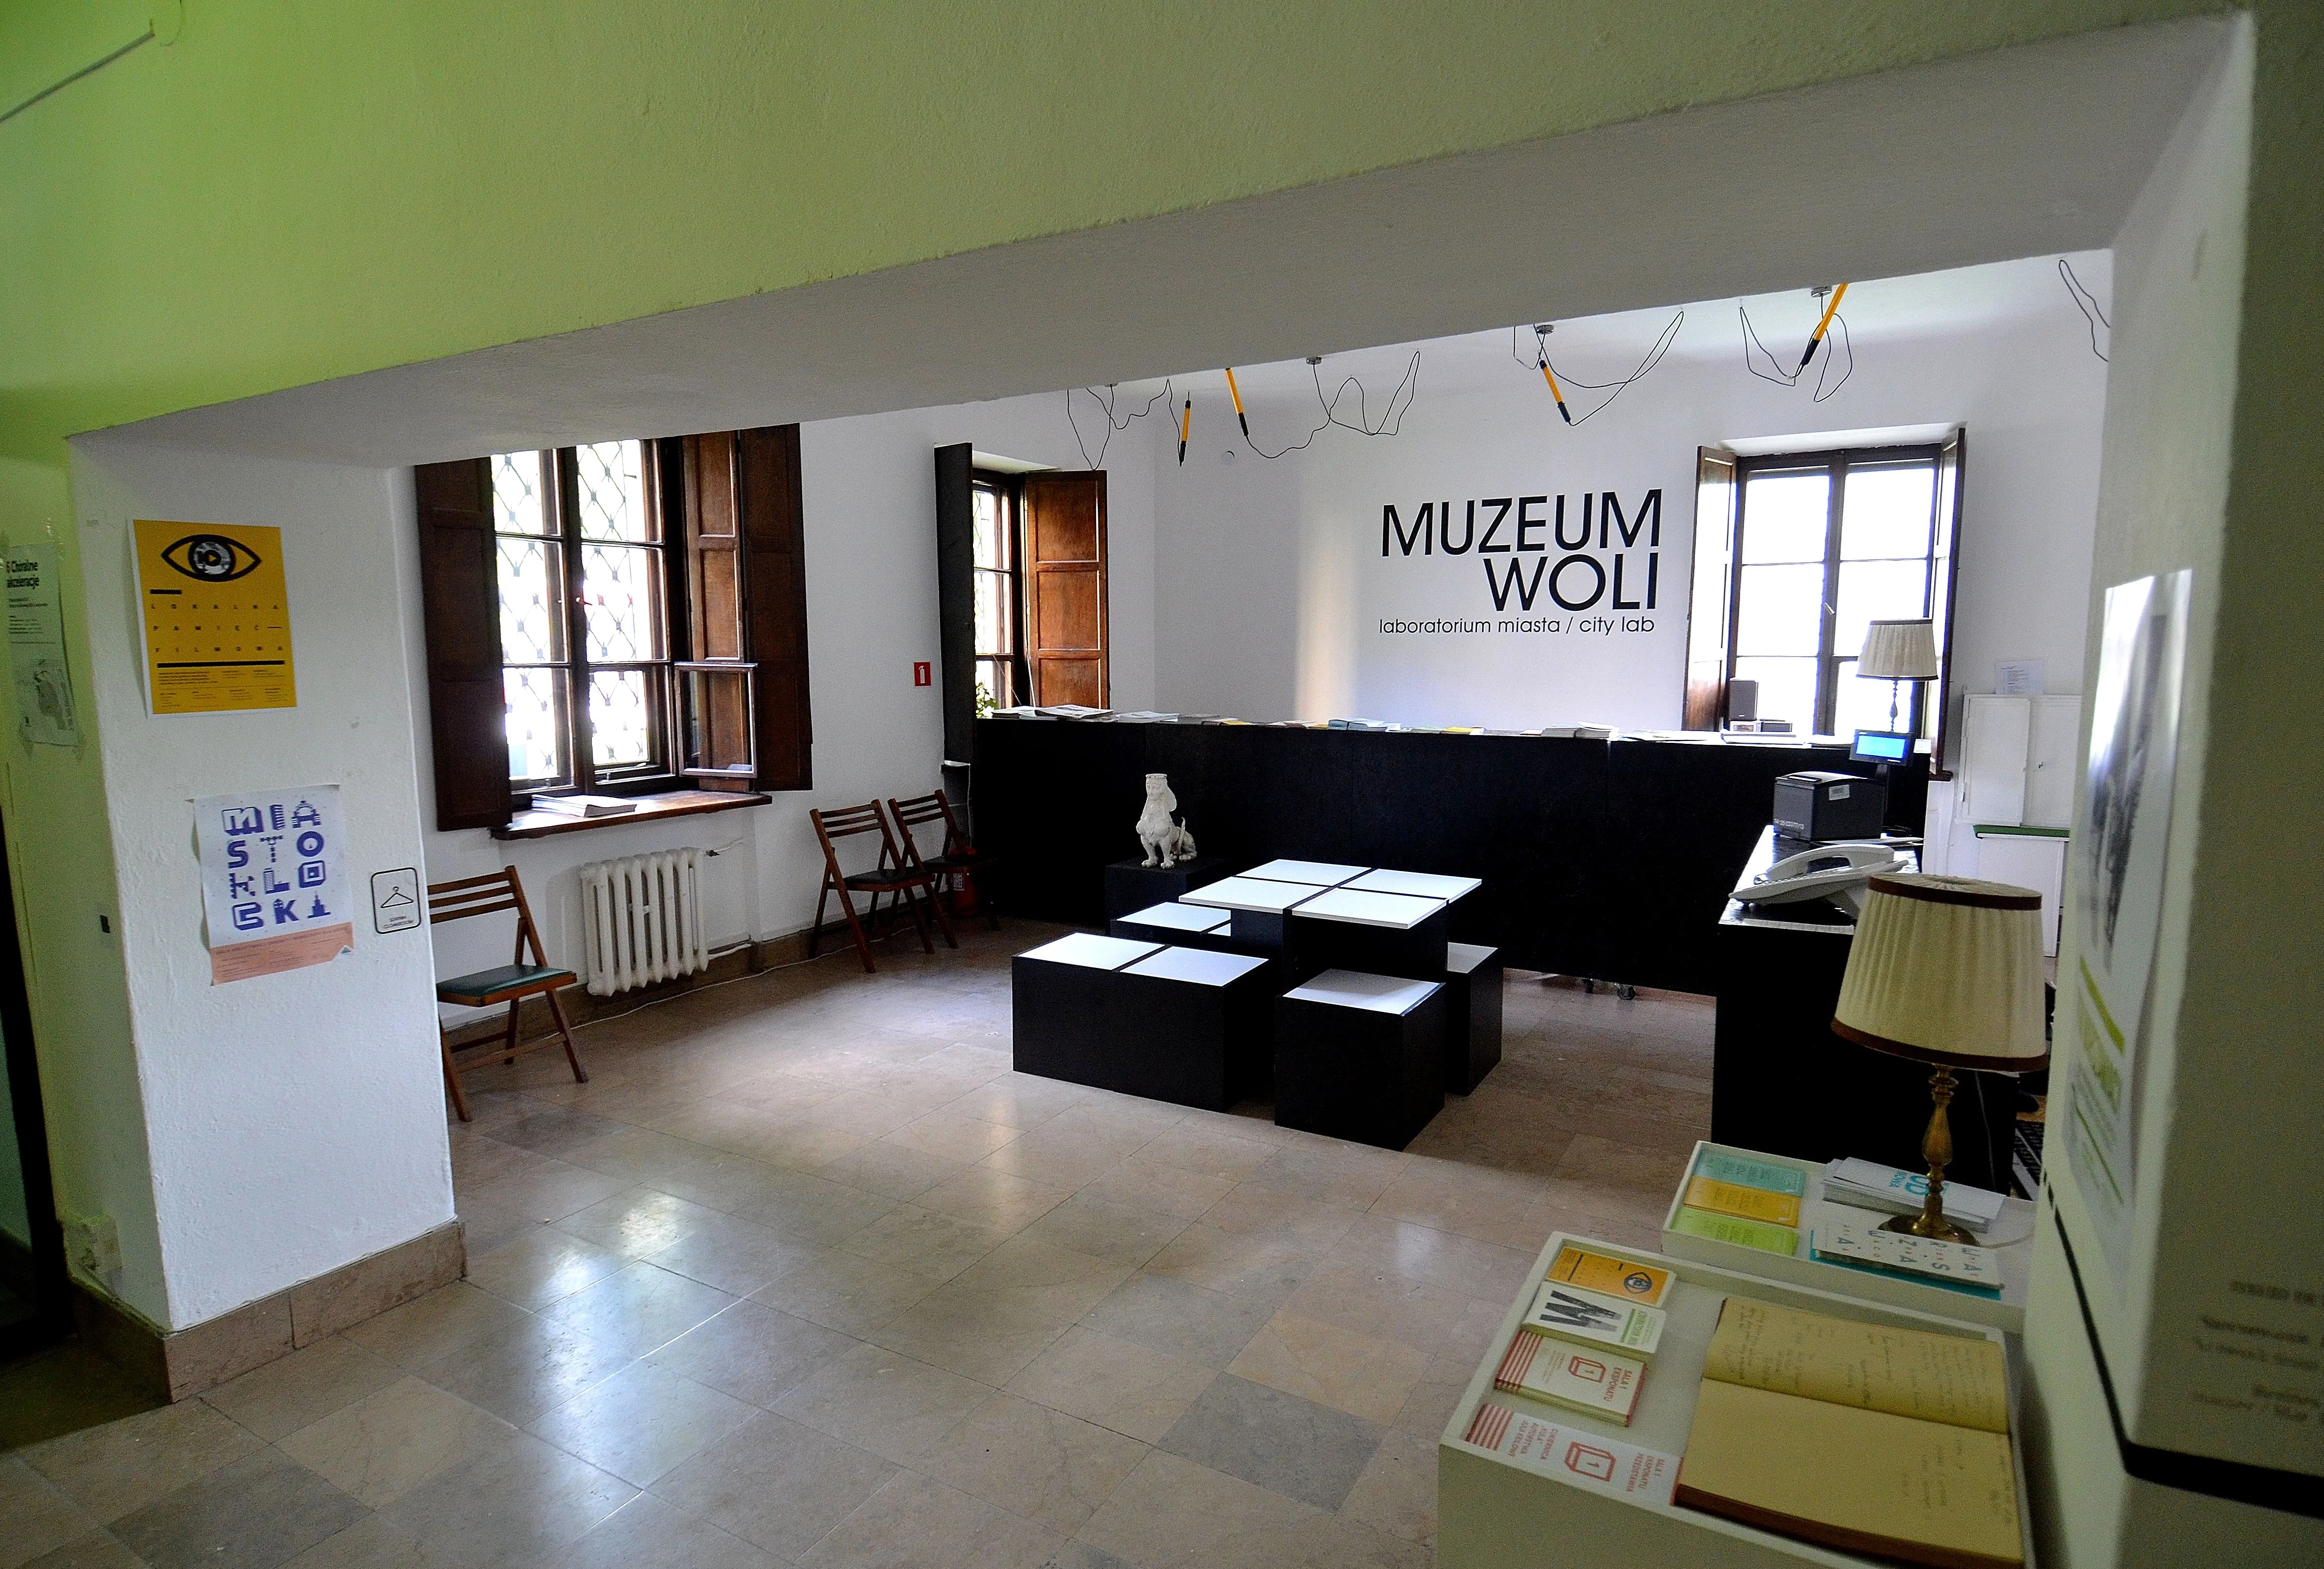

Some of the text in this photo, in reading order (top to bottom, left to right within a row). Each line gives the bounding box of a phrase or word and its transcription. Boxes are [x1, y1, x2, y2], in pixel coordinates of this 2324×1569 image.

[1382, 489, 1662, 557] MUZEUM
[1483, 552, 1659, 612] WOLI
[1379, 616, 1655, 636] laboratorium miasta / city lab
